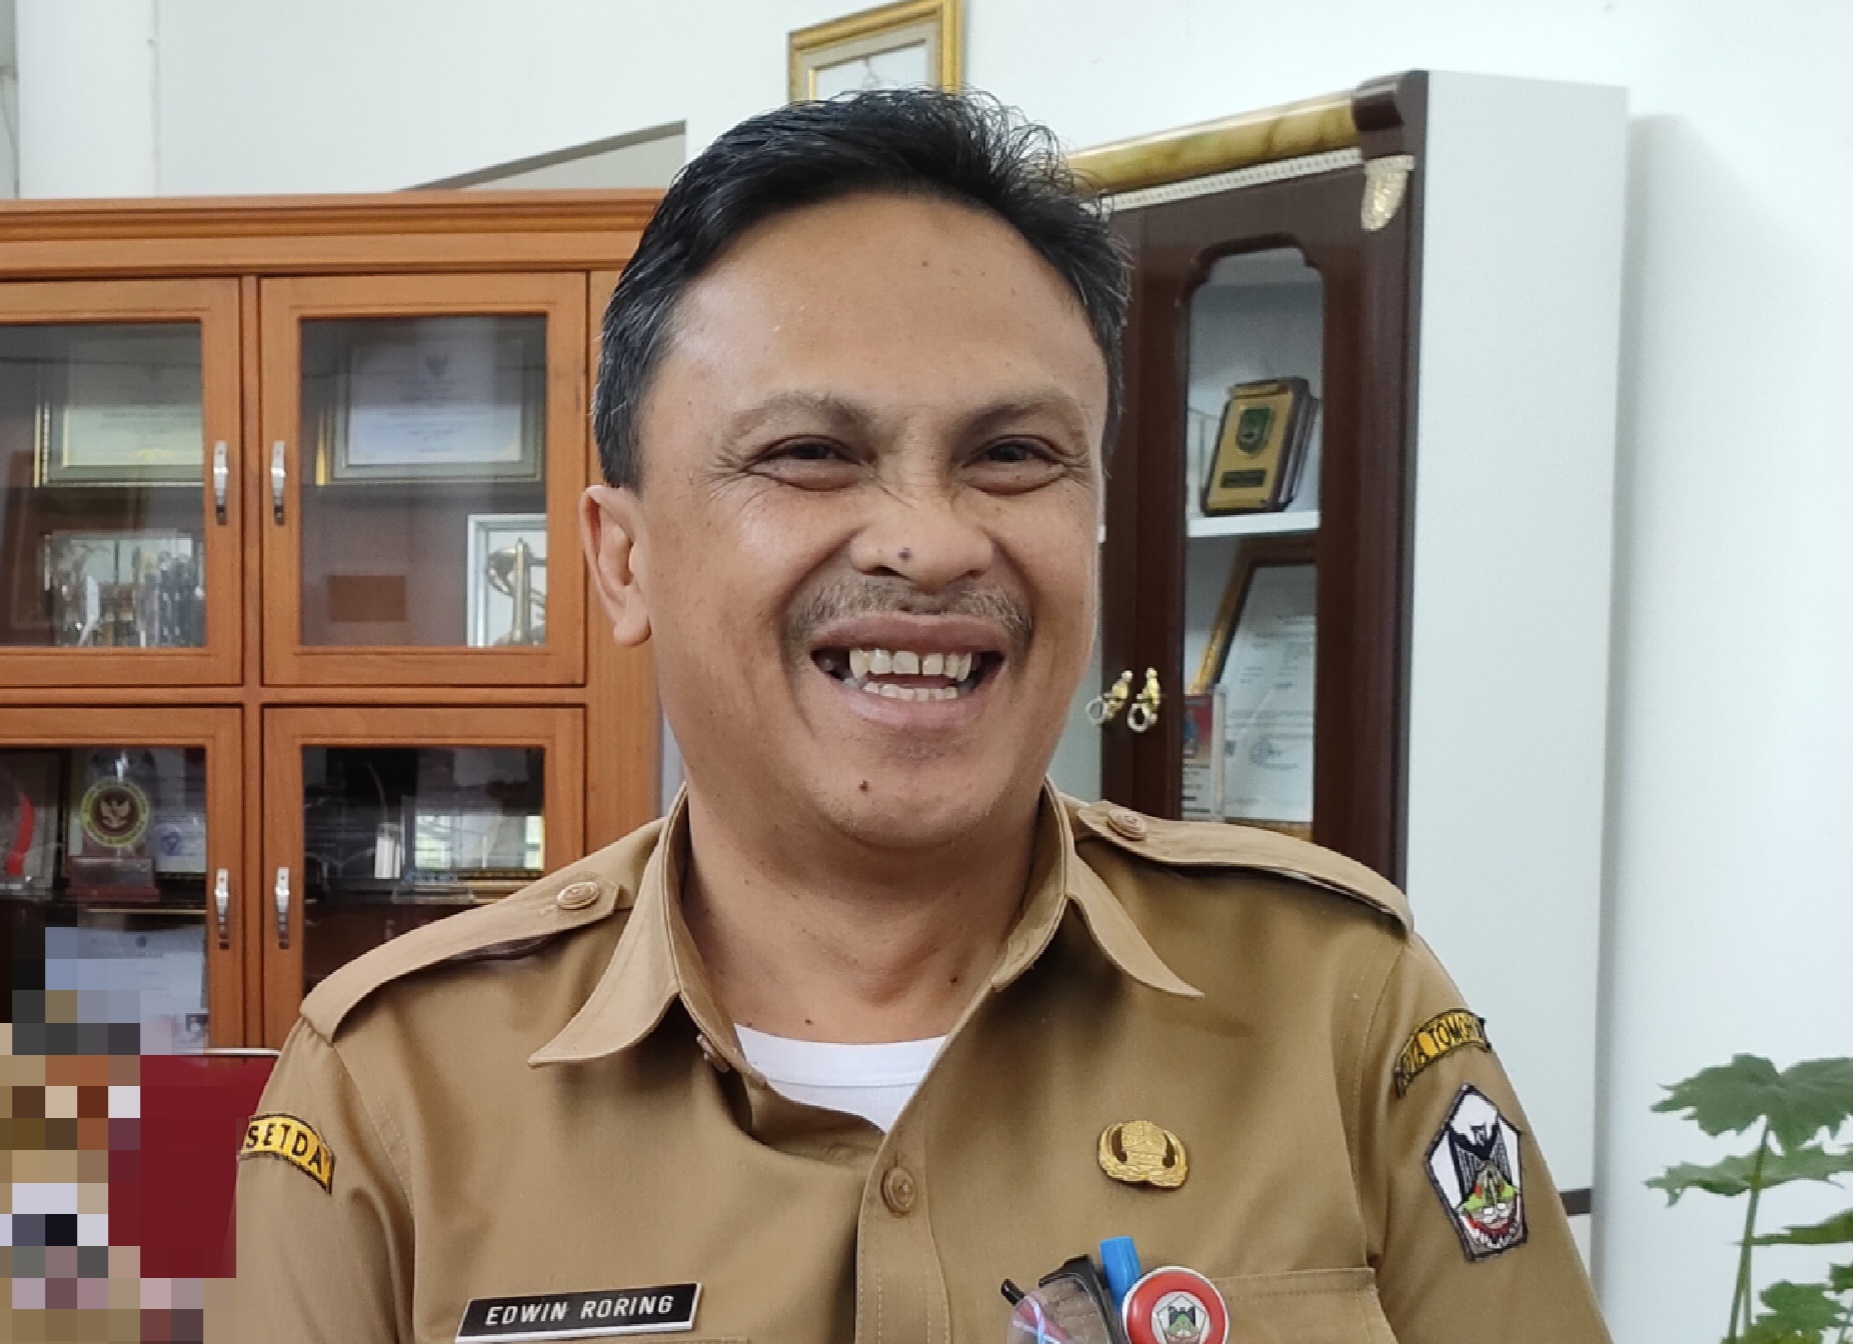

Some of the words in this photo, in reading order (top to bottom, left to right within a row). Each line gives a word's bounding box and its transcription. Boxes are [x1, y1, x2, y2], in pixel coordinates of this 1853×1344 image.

[246, 1123, 322, 1175] SETDA
[485, 1302, 568, 1326] EDWIN
[580, 1295, 674, 1320] RORING
